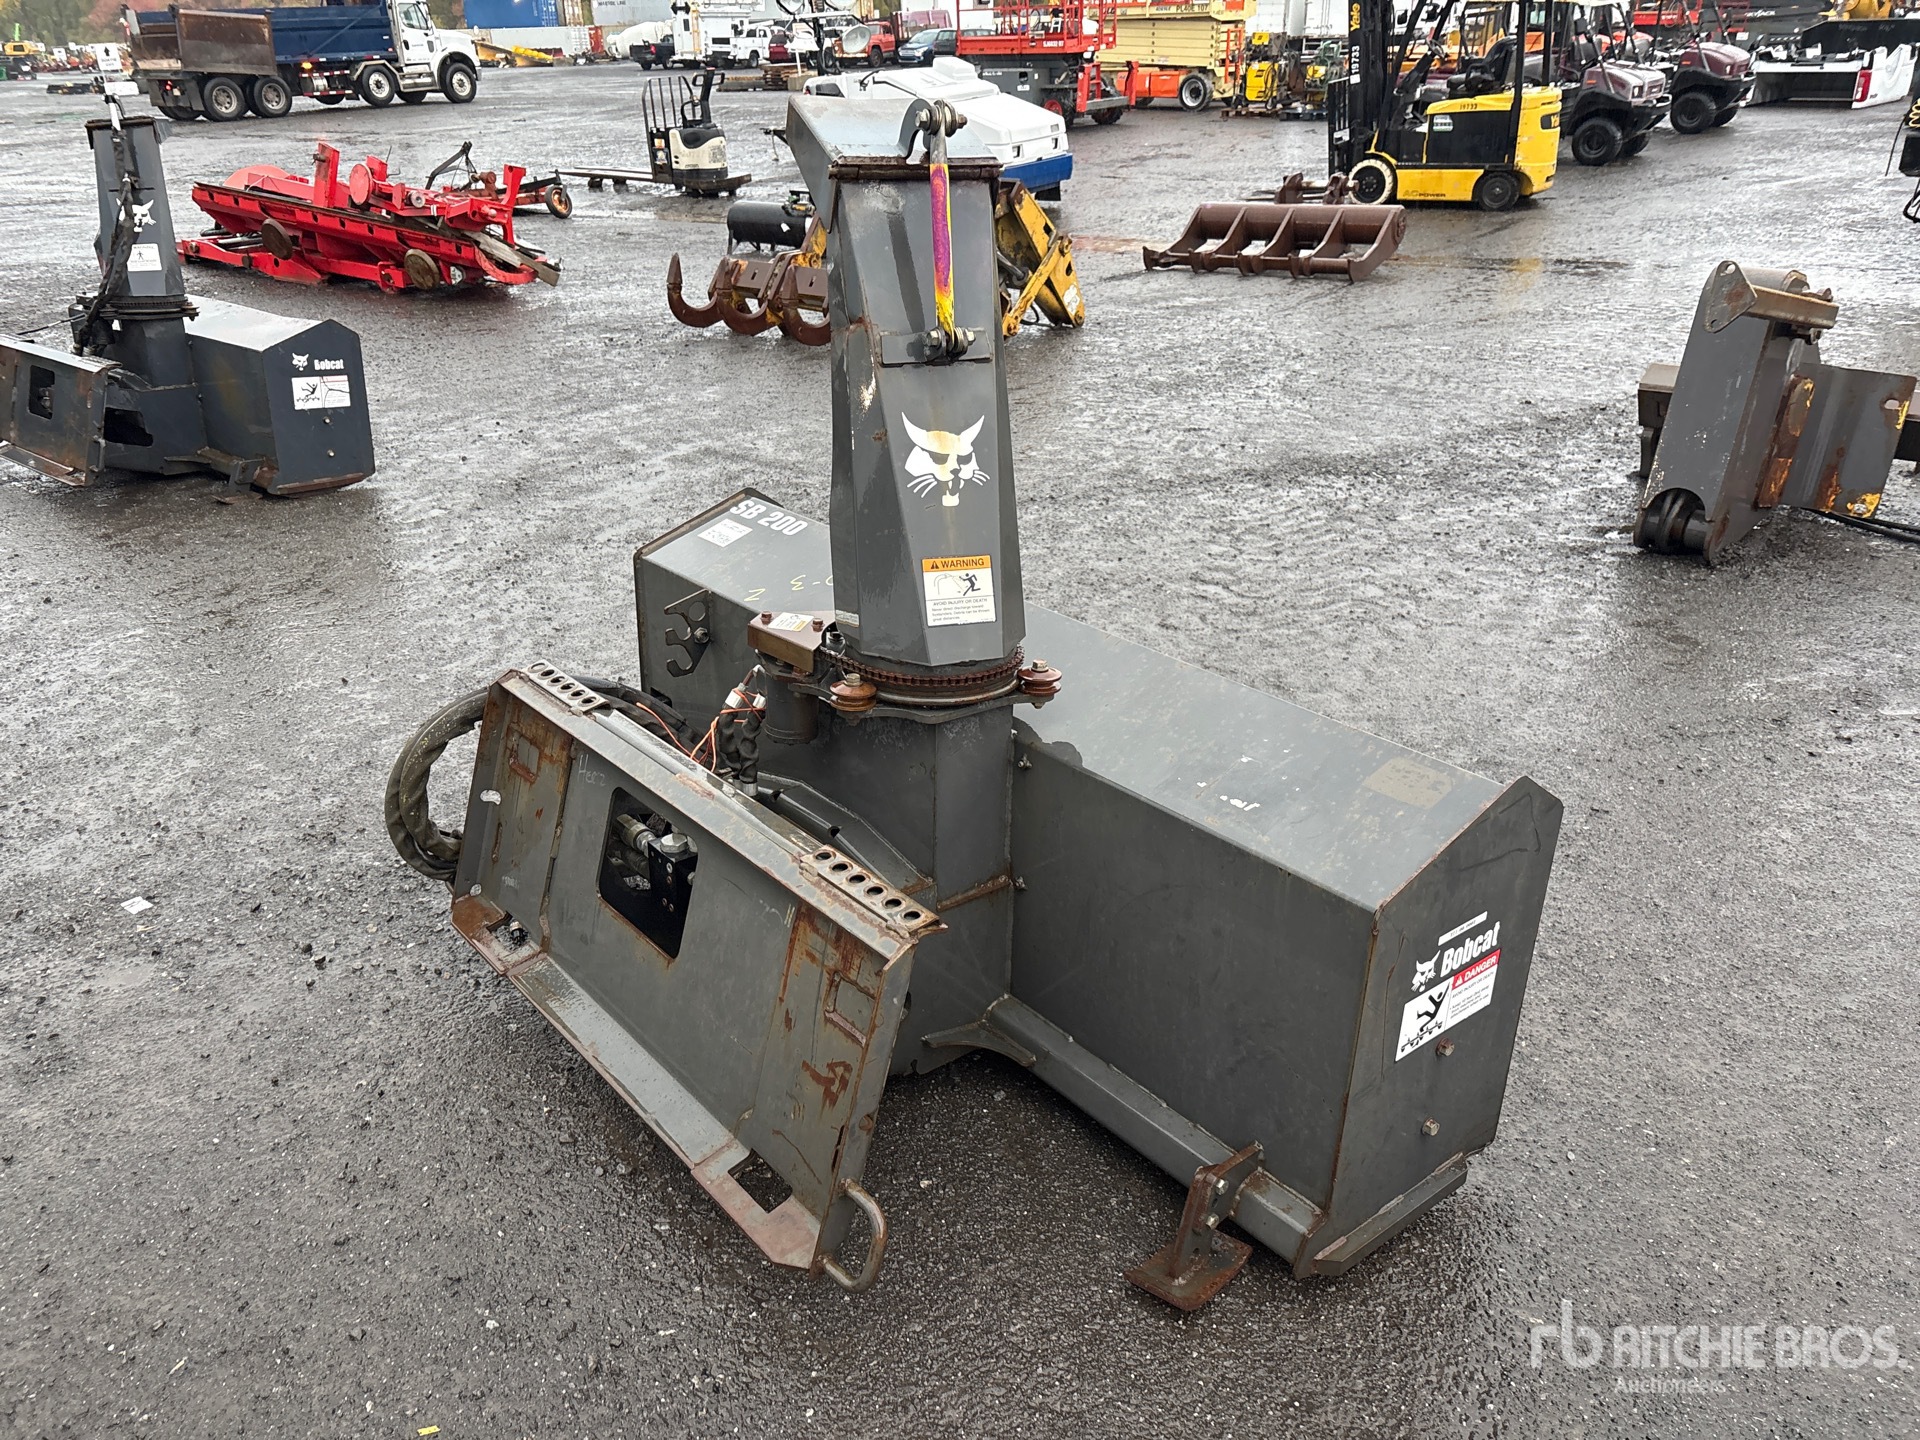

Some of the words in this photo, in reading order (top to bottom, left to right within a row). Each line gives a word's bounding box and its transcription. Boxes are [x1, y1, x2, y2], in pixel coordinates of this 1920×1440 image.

[1350, 3, 1361, 31] Yale
[1351, 45, 1360, 74] 19733
[314, 358, 345, 370] Bobcat
[730, 500, 766, 519] SB
[757, 511, 808, 535] 200
[941, 558, 984, 568] WARNING
[1440, 920, 1501, 978] Bobcat
[1464, 955, 1497, 983] DANGER
